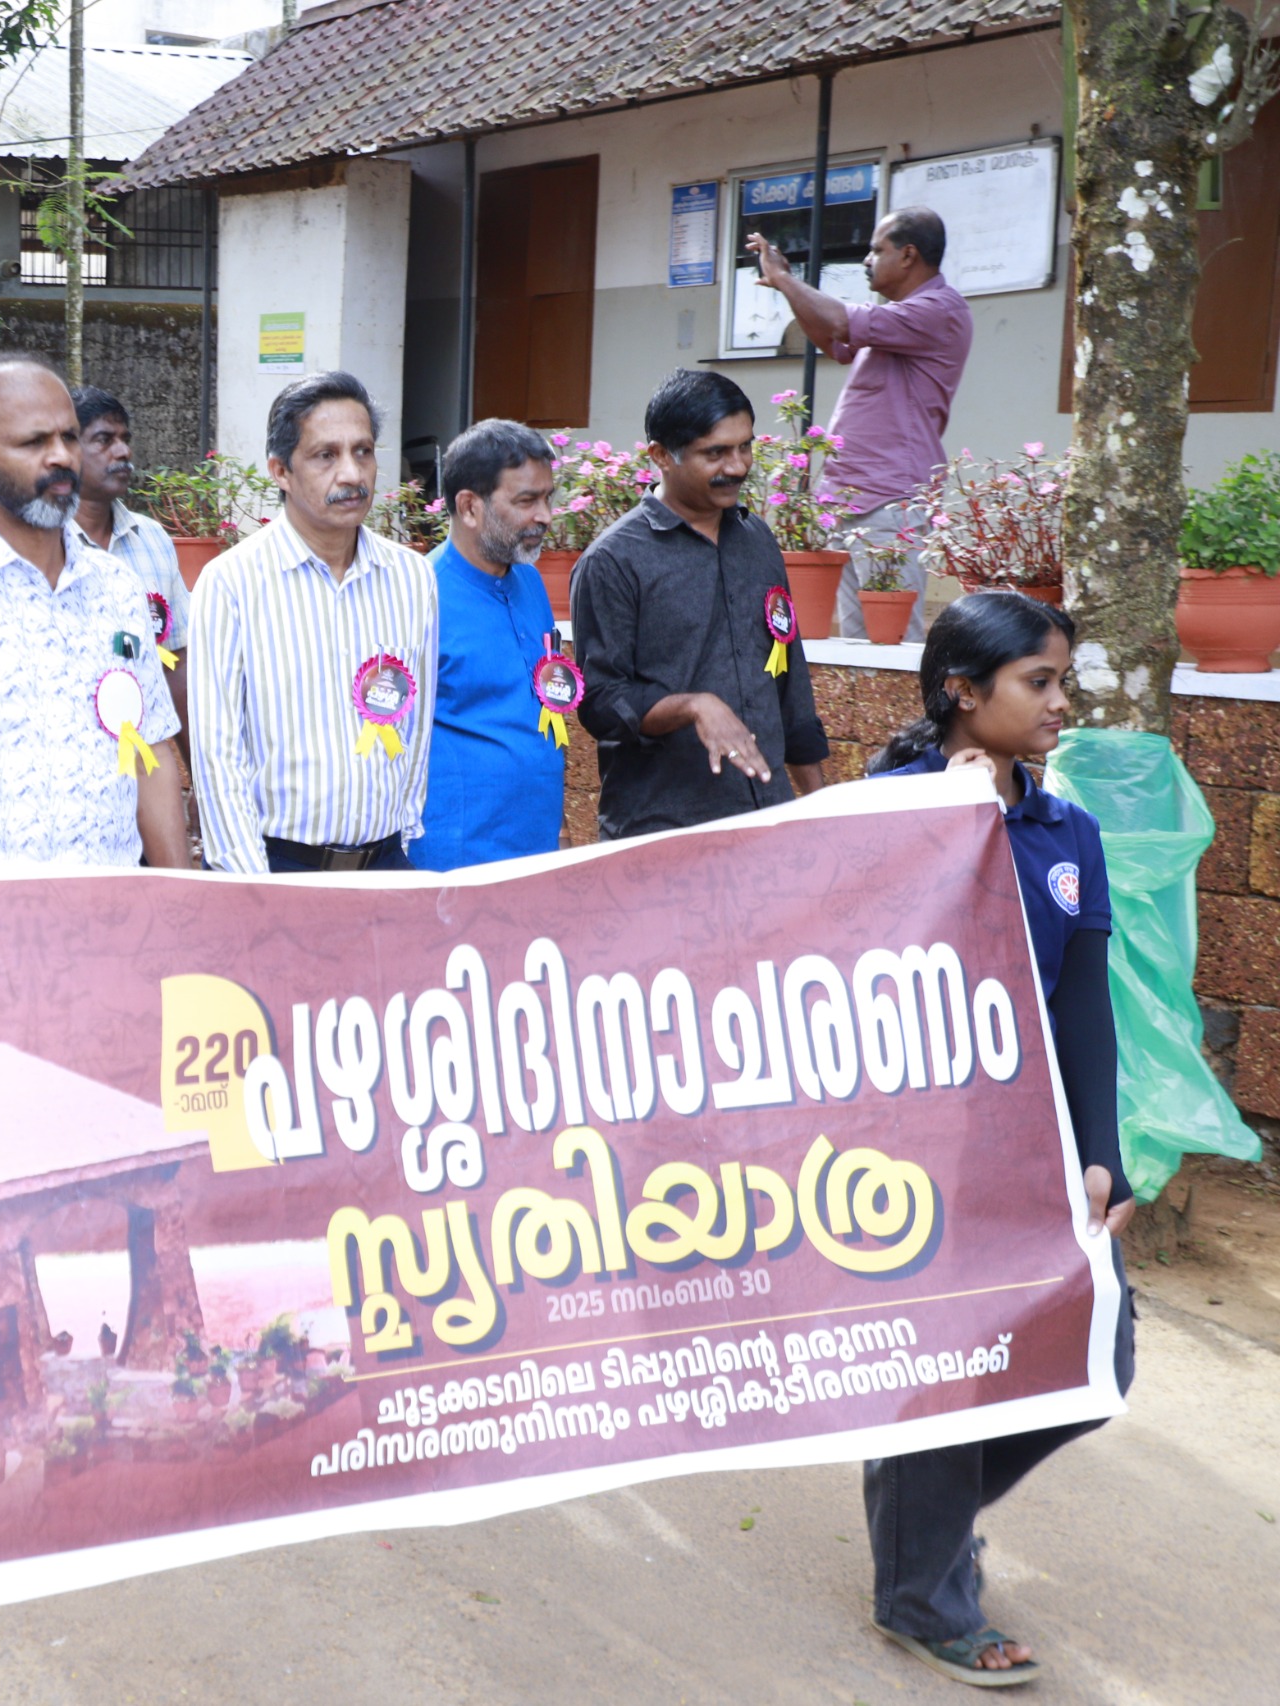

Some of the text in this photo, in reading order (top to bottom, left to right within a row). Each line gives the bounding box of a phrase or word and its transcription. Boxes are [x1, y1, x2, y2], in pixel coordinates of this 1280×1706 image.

[751, 170, 864, 205] ടിക്കറ്റ് കണ്ടർ
[175, 1029, 258, 1086] 220
[326, 1125, 934, 1354] സ്മൃതിയാത്ര
[546, 1268, 772, 1323] 2025 നവംബർ 30
[783, 1317, 918, 1364] മരുന്നറ
[310, 1400, 631, 1477] പരിസരത്തുനിന്നും
